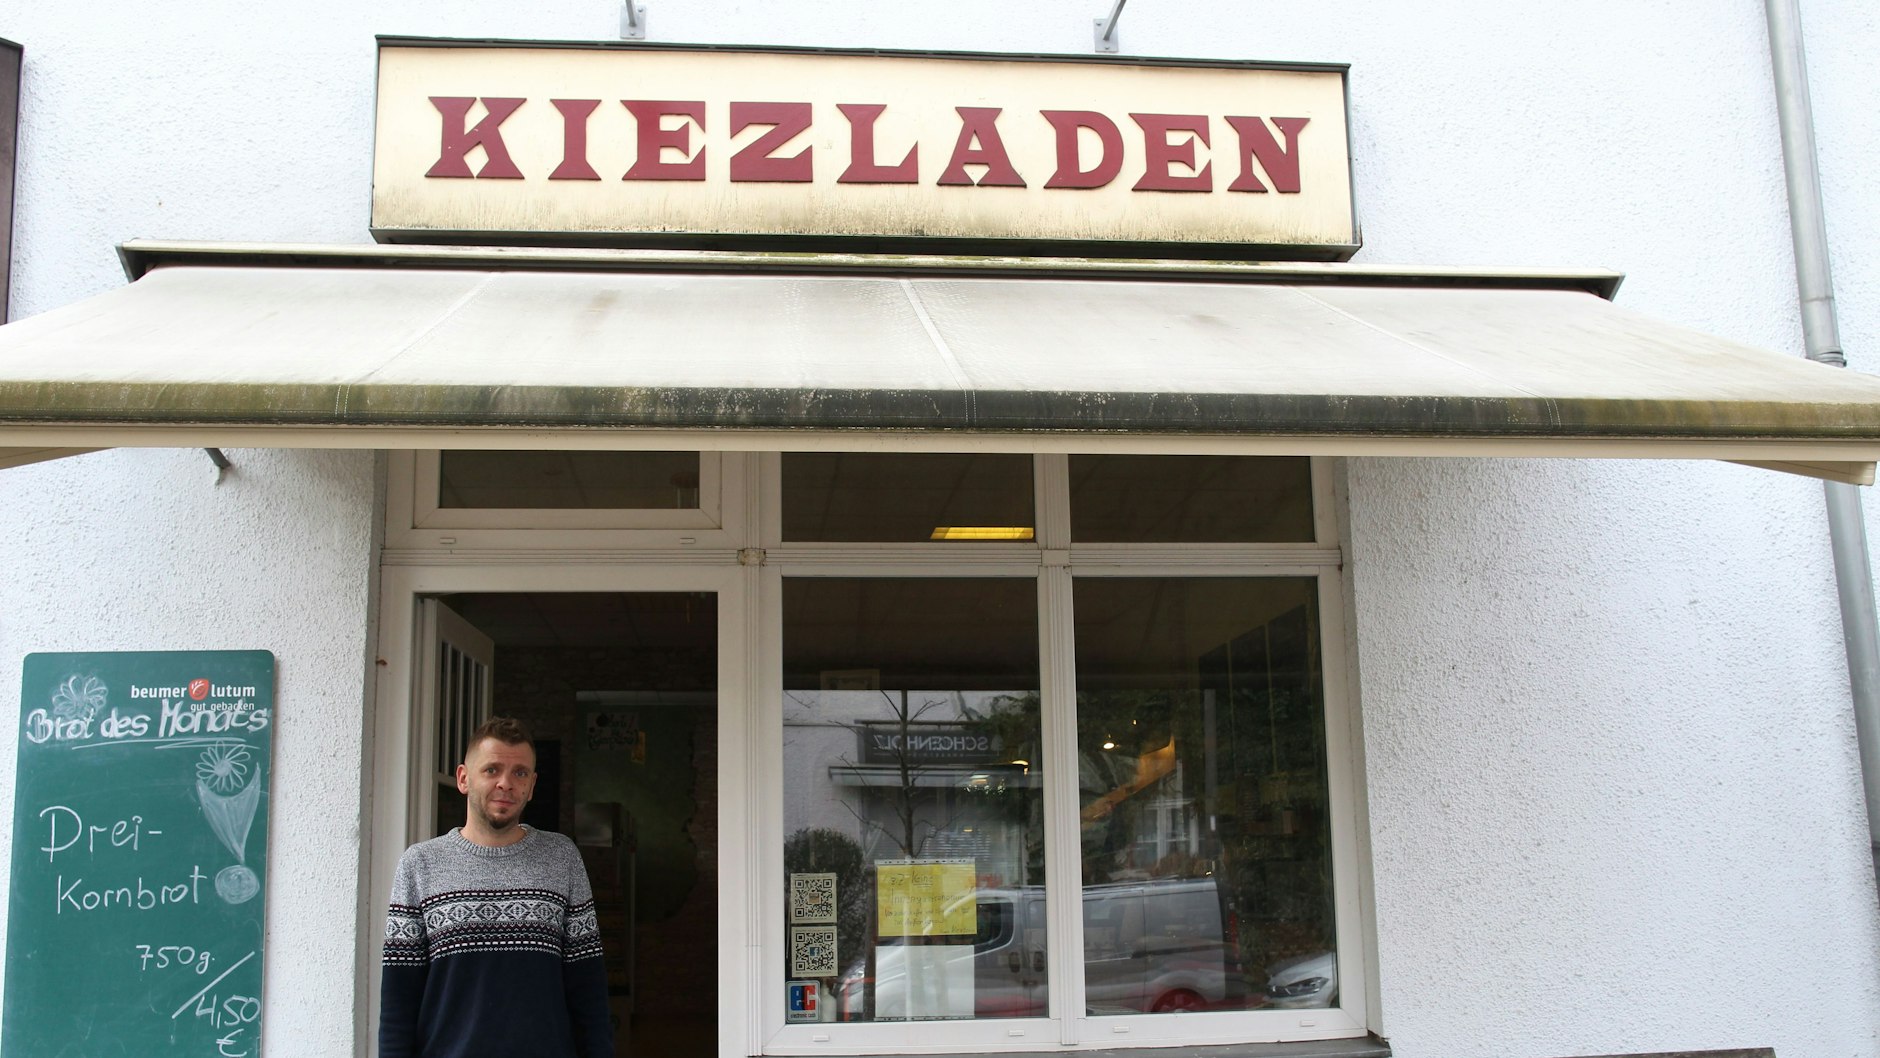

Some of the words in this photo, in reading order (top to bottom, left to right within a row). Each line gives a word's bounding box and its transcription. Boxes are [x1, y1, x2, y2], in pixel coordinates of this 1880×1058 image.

[425, 96, 1312, 194] KIEZLADEN
[131, 684, 187, 699] beumer
[211, 683, 256, 698] lutum
[190, 702, 206, 712] gut
[26, 707, 95, 744] Brot
[100, 704, 149, 737] des
[158, 699, 268, 738] Monats
[39, 805, 163, 862] Drei-
[57, 865, 207, 914] Kornbrot
